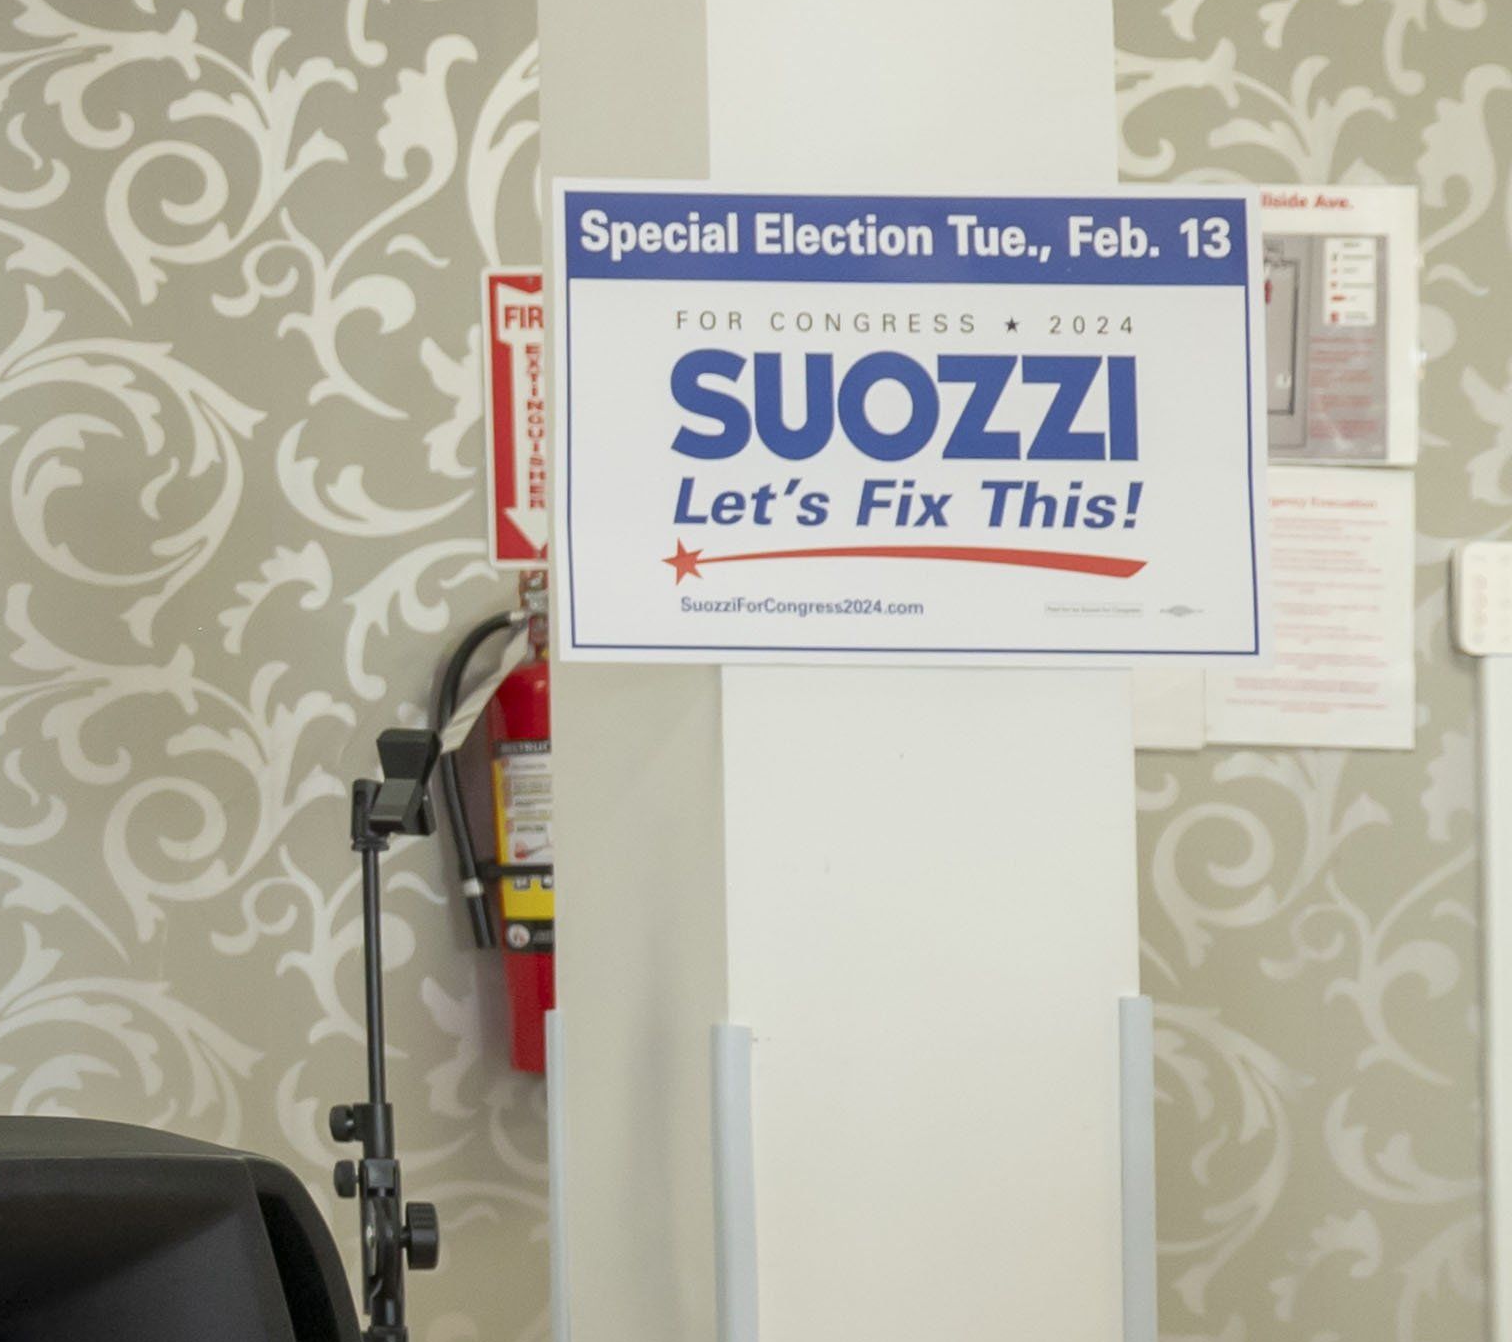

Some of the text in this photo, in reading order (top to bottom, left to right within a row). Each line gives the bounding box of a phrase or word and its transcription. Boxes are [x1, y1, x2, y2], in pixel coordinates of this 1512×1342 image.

[1260, 192, 1308, 208] llside
[581, 210, 1231, 262] Special Election Tue., Feb. 13
[505, 306, 544, 329] FIR
[677, 311, 1136, 334] FOR CONGRESS 2024
[671, 349, 1138, 462] SUOZZI
[526, 344, 546, 508] EXTINGUISHER
[674, 477, 1143, 529] Let's Fix This!
[681, 597, 923, 617] SuozziForCongress2024.com
